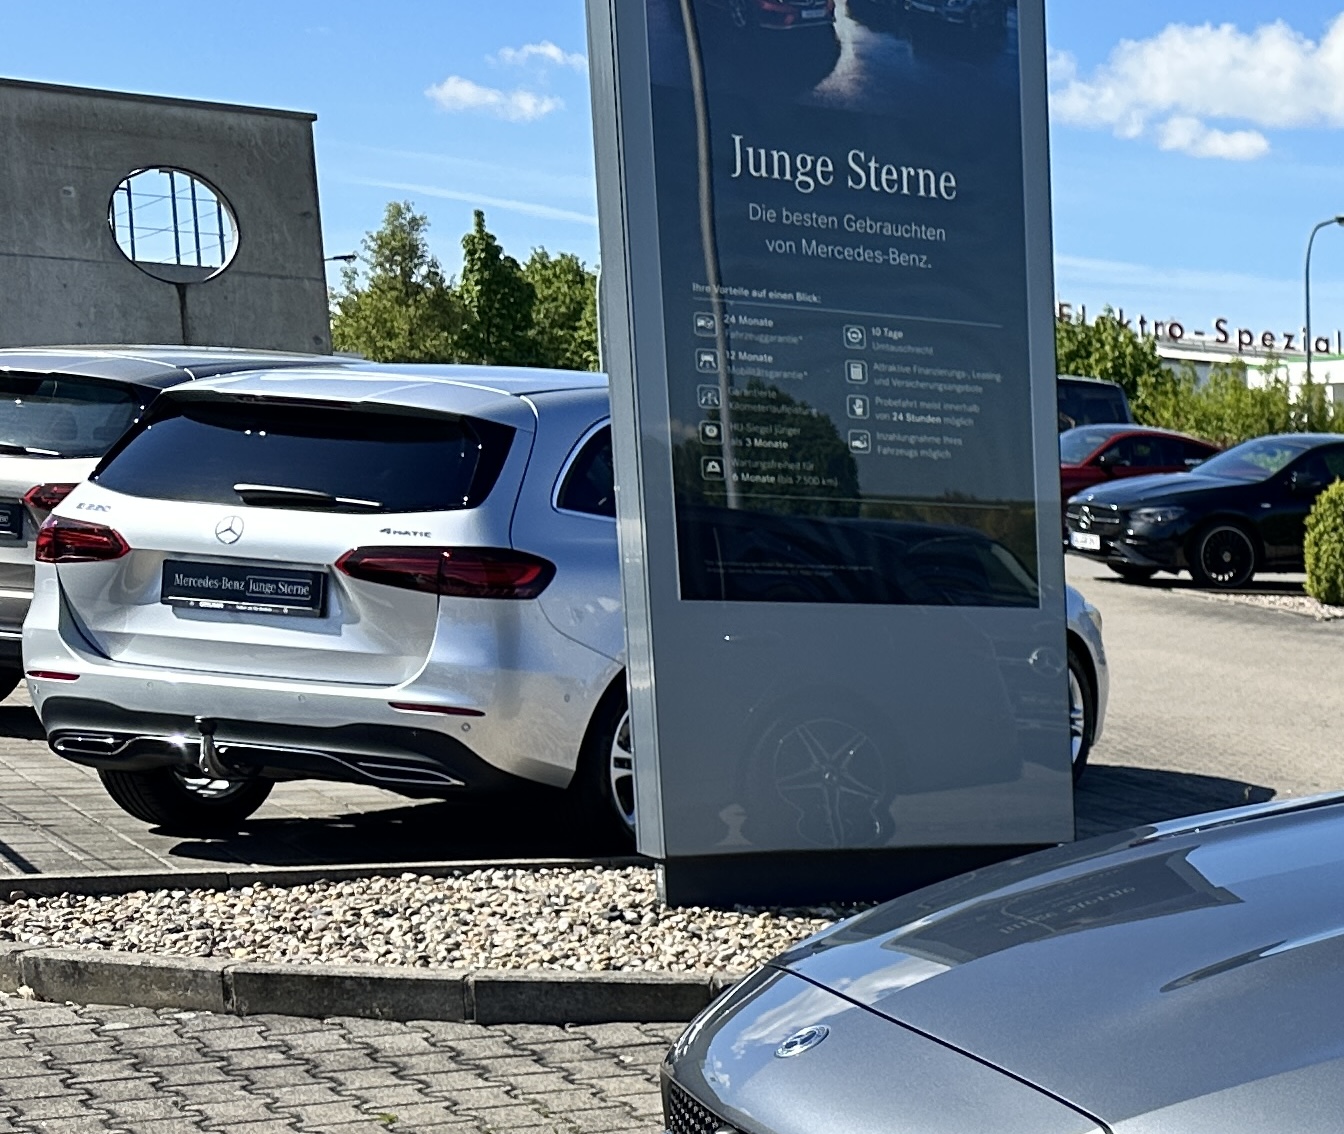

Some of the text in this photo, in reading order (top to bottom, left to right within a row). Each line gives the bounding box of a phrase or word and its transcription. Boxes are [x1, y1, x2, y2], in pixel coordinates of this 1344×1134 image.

[731, 133, 957, 201] Junge Sterne
[748, 202, 946, 242] Die besten Gebrauchten
[765, 238, 932, 269] von Mercedes-Benz.
[692, 282, 711, 294] Ihre
[710, 284, 750, 298] Vorteile
[751, 287, 766, 299] auf
[768, 290, 794, 301] einen
[723, 314, 774, 328] 24 Monate
[871, 326, 904, 340] 10 Tage
[726, 350, 774, 364] 12 Monate
[892, 411, 904, 422] 24
[905, 412, 942, 424] Stunden
[745, 437, 752, 448] 3
[753, 438, 789, 450] Monate
[732, 473, 739, 482] 6
[741, 472, 776, 485] Monate
[174, 573, 310, 596] Mercedes-Benz Junge Sterne
